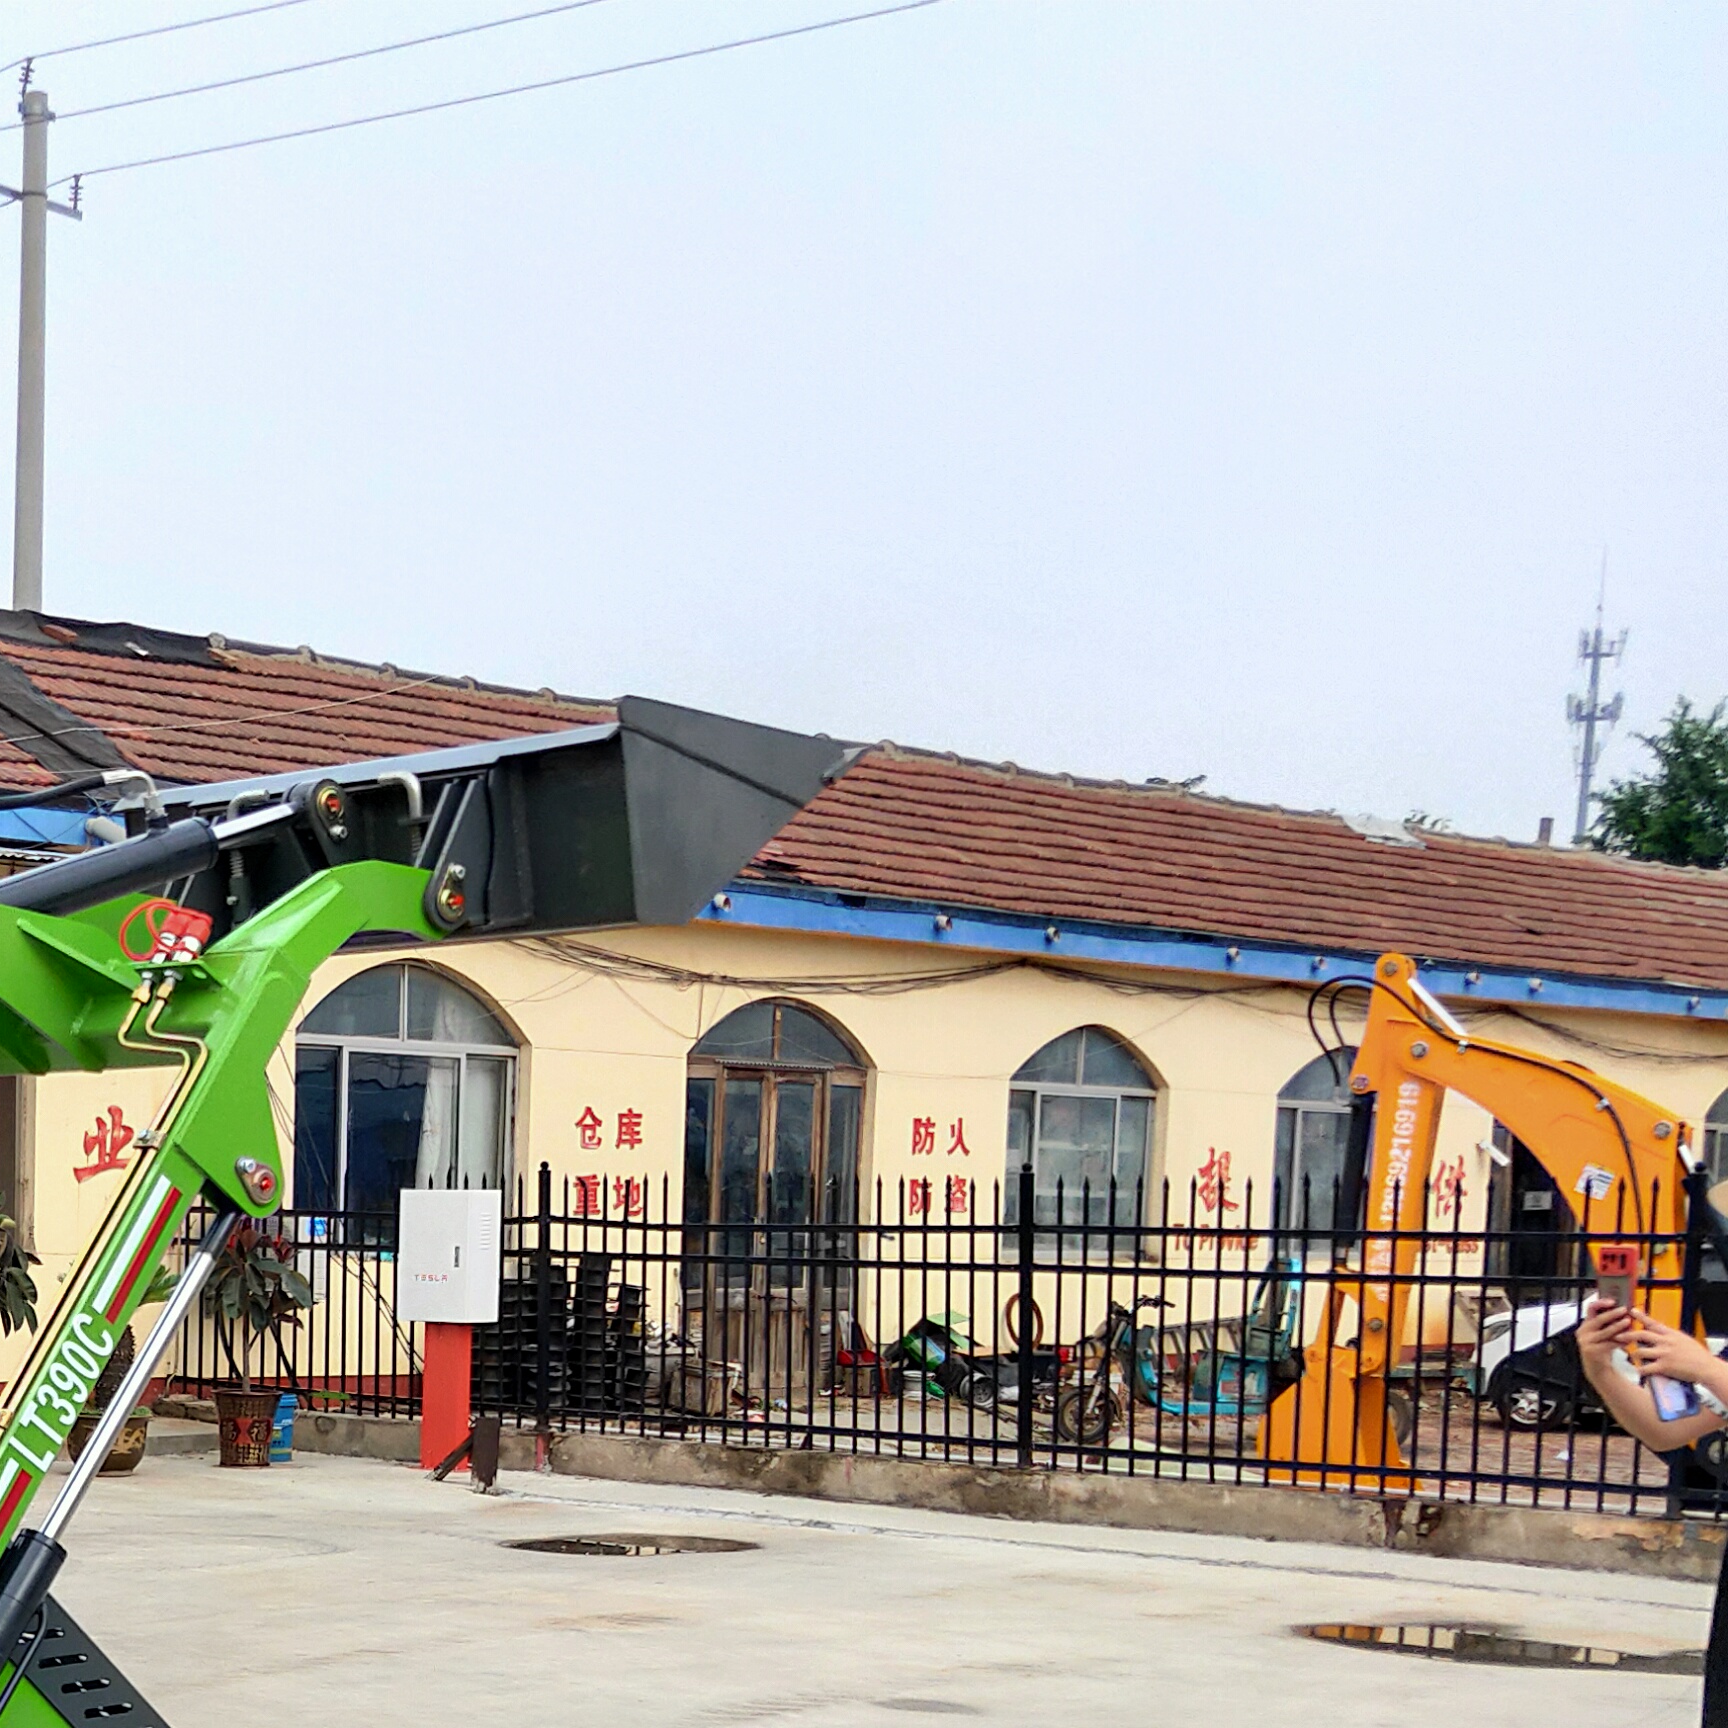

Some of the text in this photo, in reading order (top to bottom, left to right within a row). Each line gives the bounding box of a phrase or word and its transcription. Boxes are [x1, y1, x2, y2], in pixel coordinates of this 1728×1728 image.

[73, 1105, 135, 1184] 业
[574, 1106, 643, 1150] 仓库
[912, 1116, 970, 1156] 防火
[573, 1174, 643, 1216] 重地
[909, 1174, 968, 1216] 防盗
[414, 1274, 448, 1282] TESLA
[8, 1313, 114, 1473] LT390C
